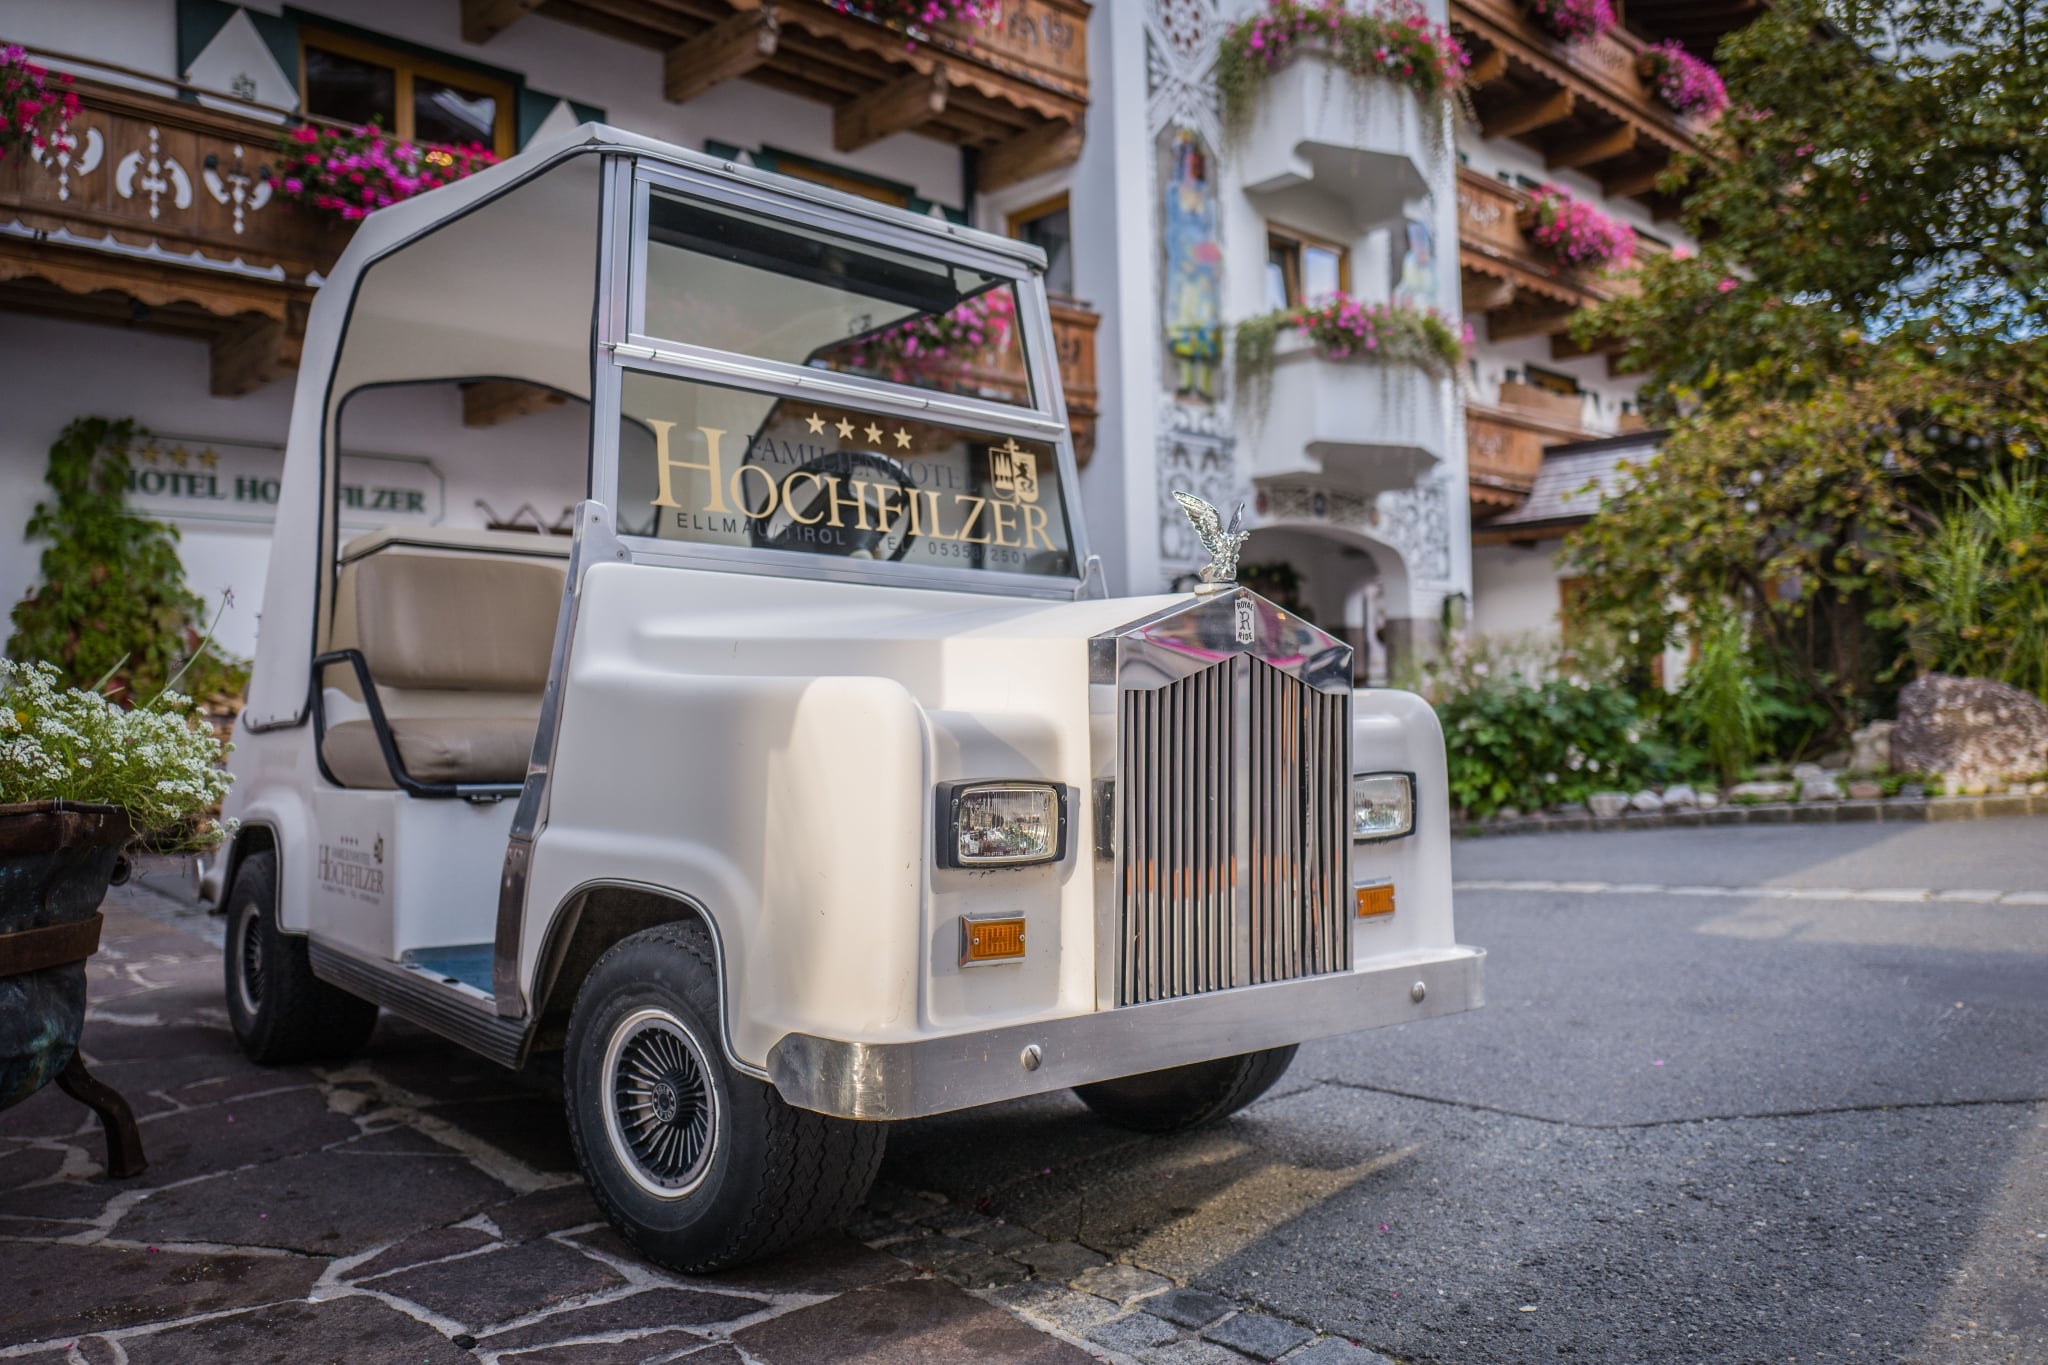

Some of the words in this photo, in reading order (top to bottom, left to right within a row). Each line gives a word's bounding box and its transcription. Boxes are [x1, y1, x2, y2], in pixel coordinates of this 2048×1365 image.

[646, 418, 1057, 552] HOCHFILZER
[1237, 600, 1253, 610] ROYAL
[1238, 632, 1253, 640] RIDE
[318, 844, 384, 894] HOCHFILZER
